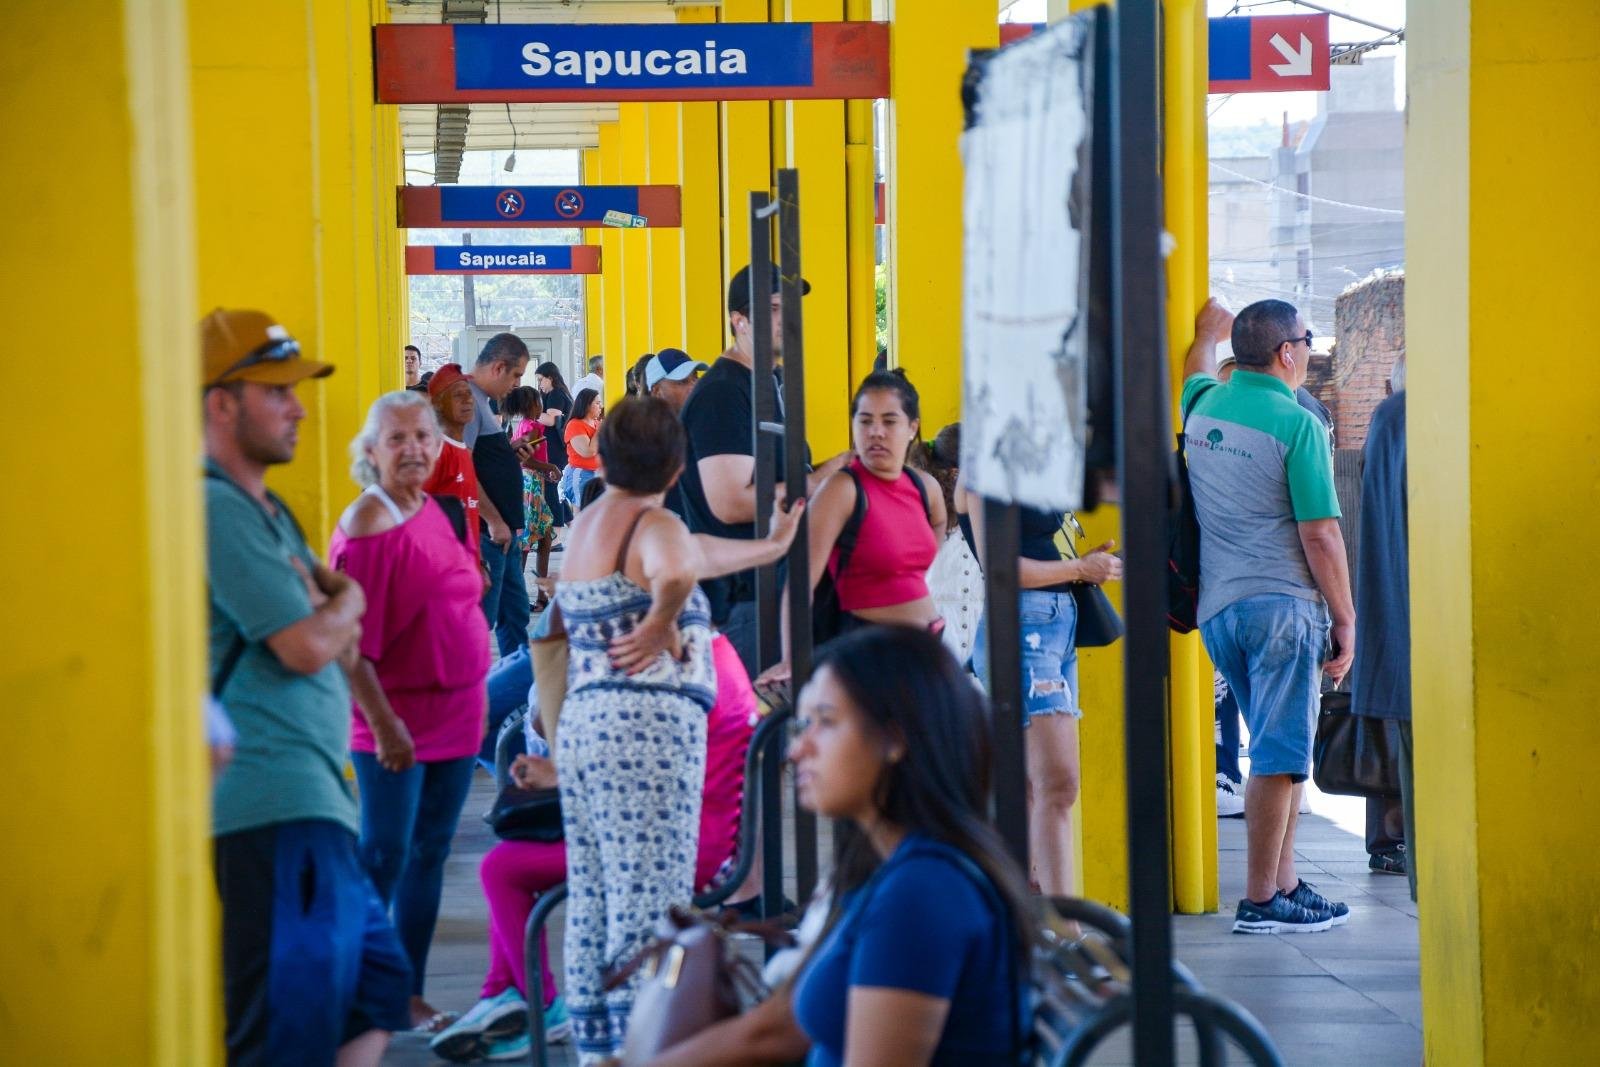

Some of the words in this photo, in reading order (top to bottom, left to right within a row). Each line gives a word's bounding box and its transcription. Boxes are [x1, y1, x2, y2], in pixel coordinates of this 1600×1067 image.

[521, 40, 748, 84] Sapucaia
[459, 251, 546, 269] Sapucaia
[1215, 443, 1253, 459] PAINEIRA
